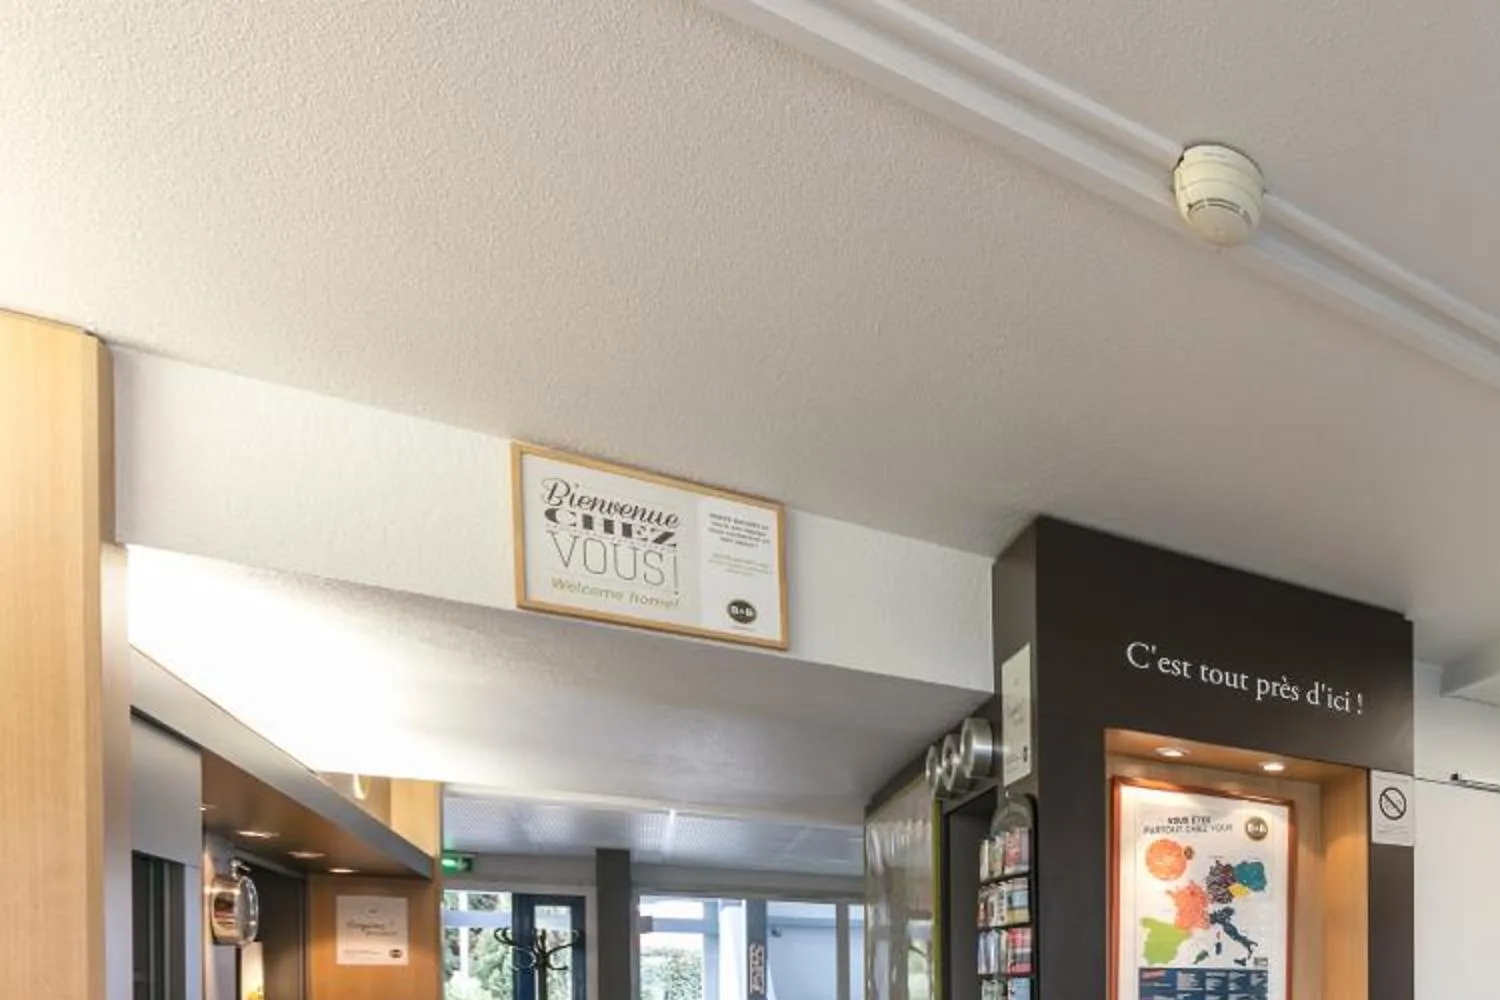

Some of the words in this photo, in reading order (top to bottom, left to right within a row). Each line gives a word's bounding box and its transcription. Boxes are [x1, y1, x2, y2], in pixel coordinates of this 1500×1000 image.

[541, 477, 681, 528] Bienvenue
[544, 507, 677, 547] CHEZ
[551, 575, 626, 600] Welcome
[629, 591, 680, 609] home!
[1126, 641, 1192, 679] C'est
[1200, 664, 1249, 691] tout
[1256, 676, 1300, 701] près
[1306, 682, 1351, 713] d'ici
